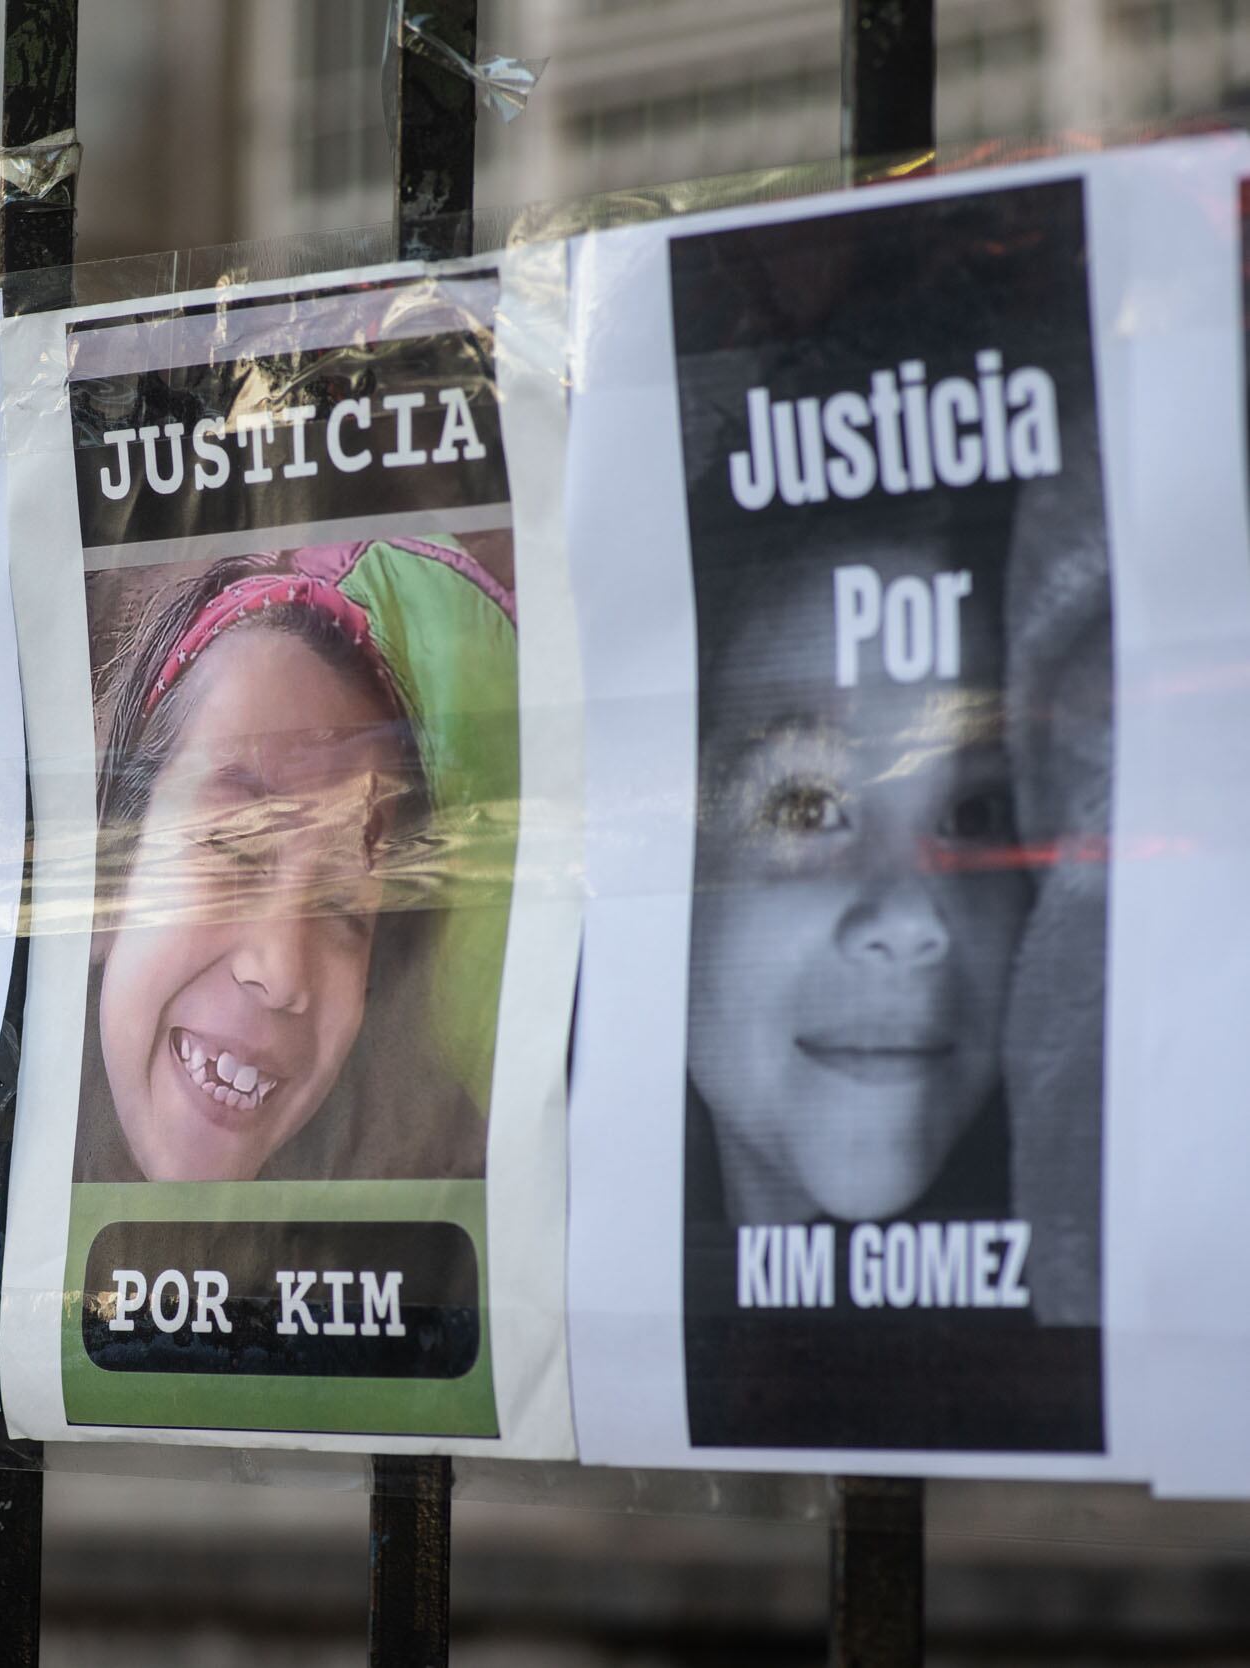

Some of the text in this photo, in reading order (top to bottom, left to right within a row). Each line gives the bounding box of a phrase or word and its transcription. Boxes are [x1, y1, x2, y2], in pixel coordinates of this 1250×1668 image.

[100, 387, 486, 499] JUSTICIA
[729, 349, 1062, 510] Justicia
[834, 566, 972, 687] Por
[108, 1269, 405, 1337] POR KIM
[737, 1220, 1032, 1308] KIM GOMEZ
